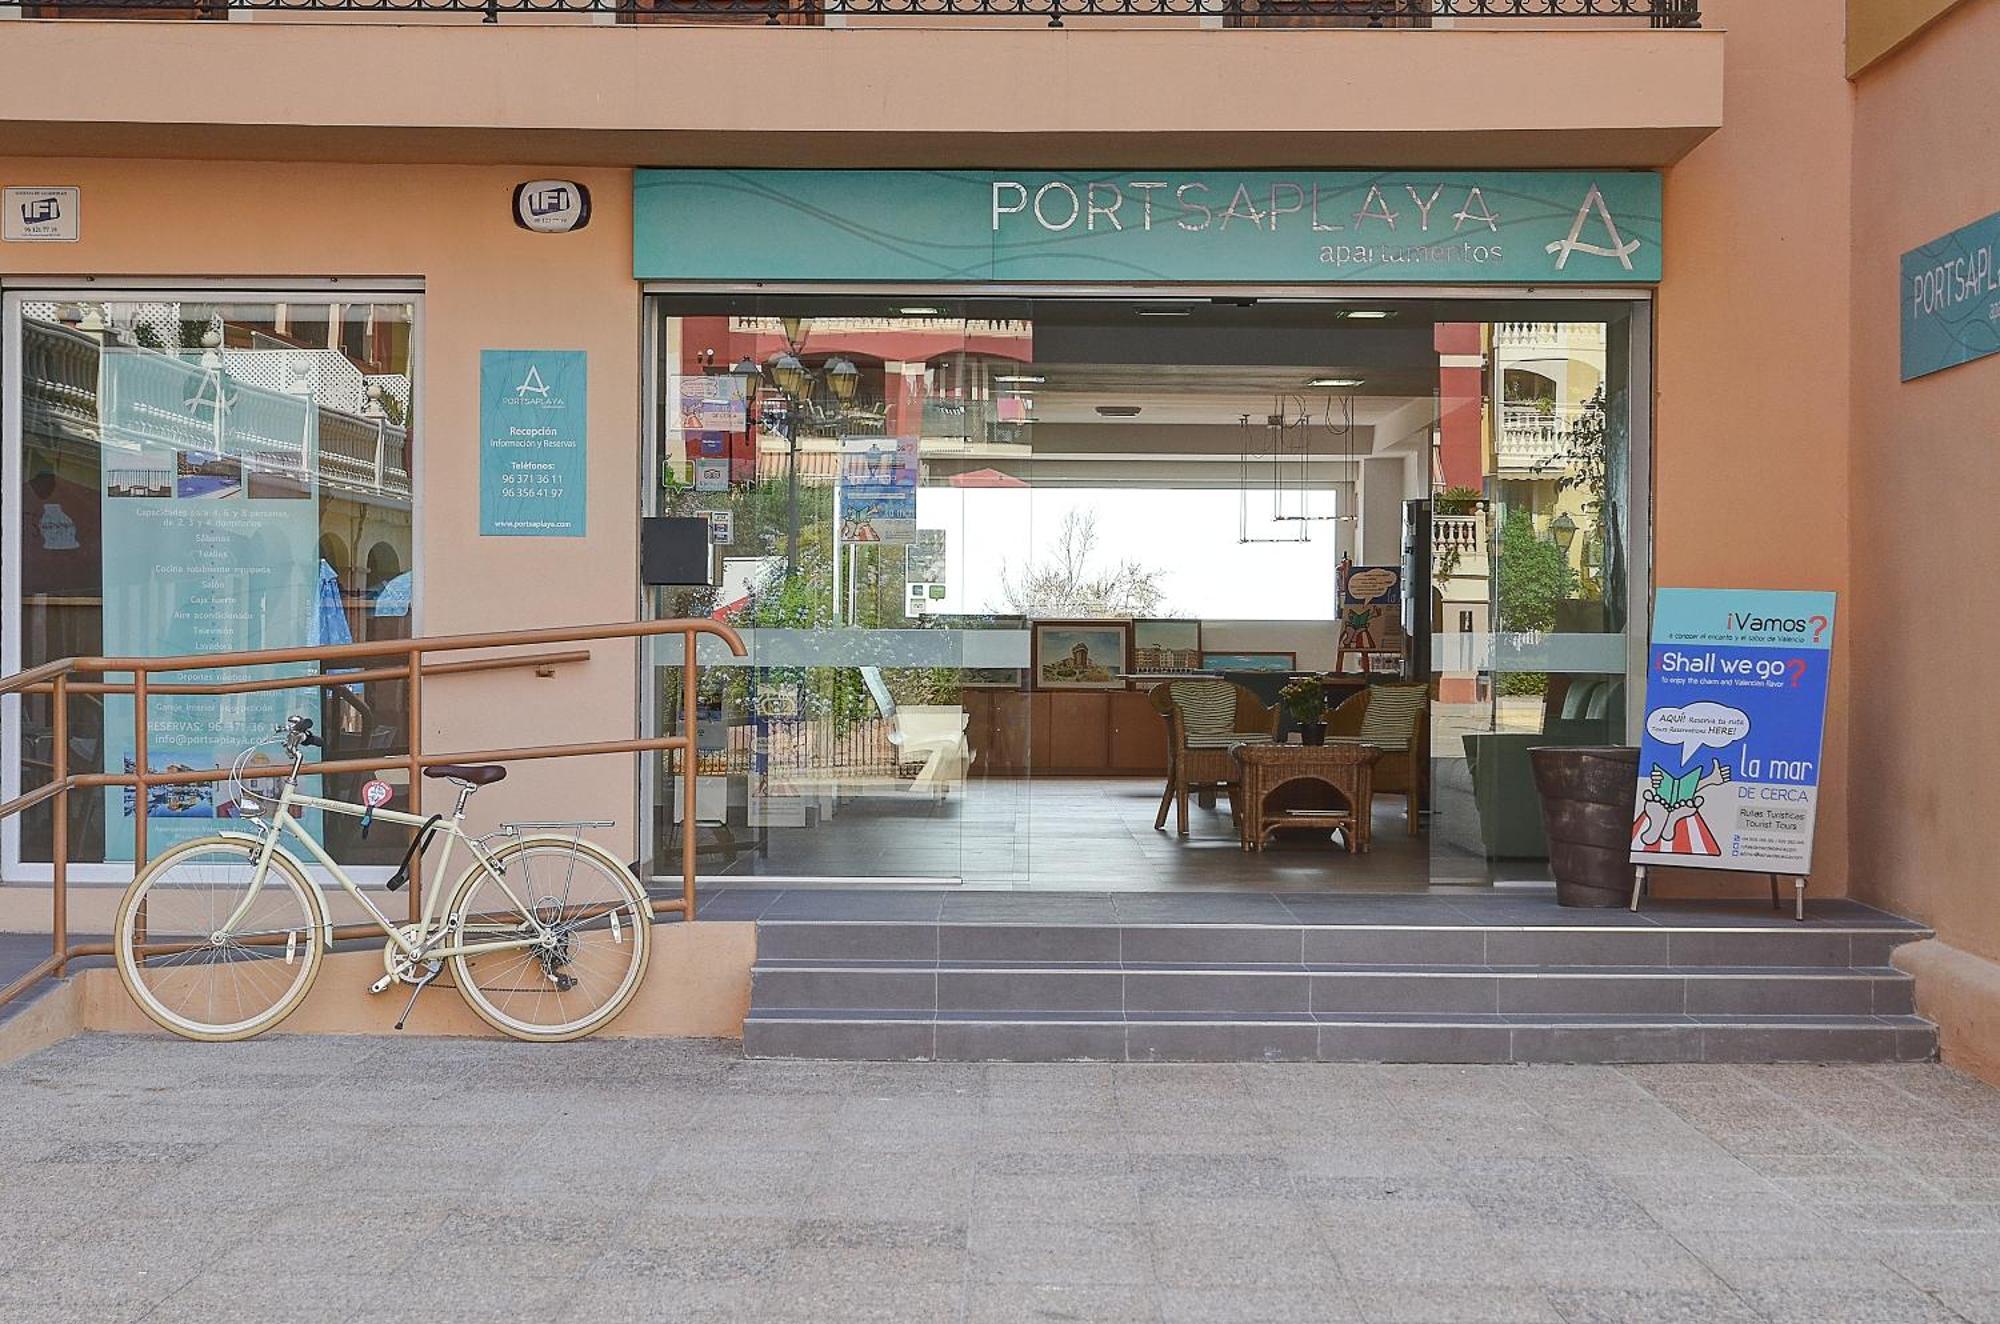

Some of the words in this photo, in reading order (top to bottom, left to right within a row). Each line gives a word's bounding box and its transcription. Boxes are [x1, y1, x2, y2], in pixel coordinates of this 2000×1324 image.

[992, 181, 1500, 232] PORTSAPLAYA
[1319, 241, 1504, 267] apartamentos
[510, 426, 557, 438] Recepción
[490, 438, 535, 448] Información
[537, 441, 542, 449] y
[543, 439, 577, 448] Reservas
[511, 461, 556, 470] Teléfonos:
[502, 474, 515, 484] 96
[516, 474, 533, 484] 371
[536, 474, 550, 484] 36
[551, 474, 563, 484] 11
[502, 488, 515, 498] 96
[516, 488, 535, 498] 356
[536, 488, 548, 498] 41
[551, 488, 564, 498] 97
[494, 520, 572, 529] www.portsaplaya.com
[1720, 659, 1753, 674] we
[1687, 676, 1699, 685] the
[1720, 677, 1733, 686] and
[1707, 726, 1737, 735] HERE!
[1740, 743, 1761, 778] la
[1768, 759, 1813, 781] mar
[1738, 786, 1757, 800] DE
[1760, 787, 1809, 802] CERCA
[1746, 819, 1772, 829] Tourist
[1775, 820, 1798, 830] Tours
